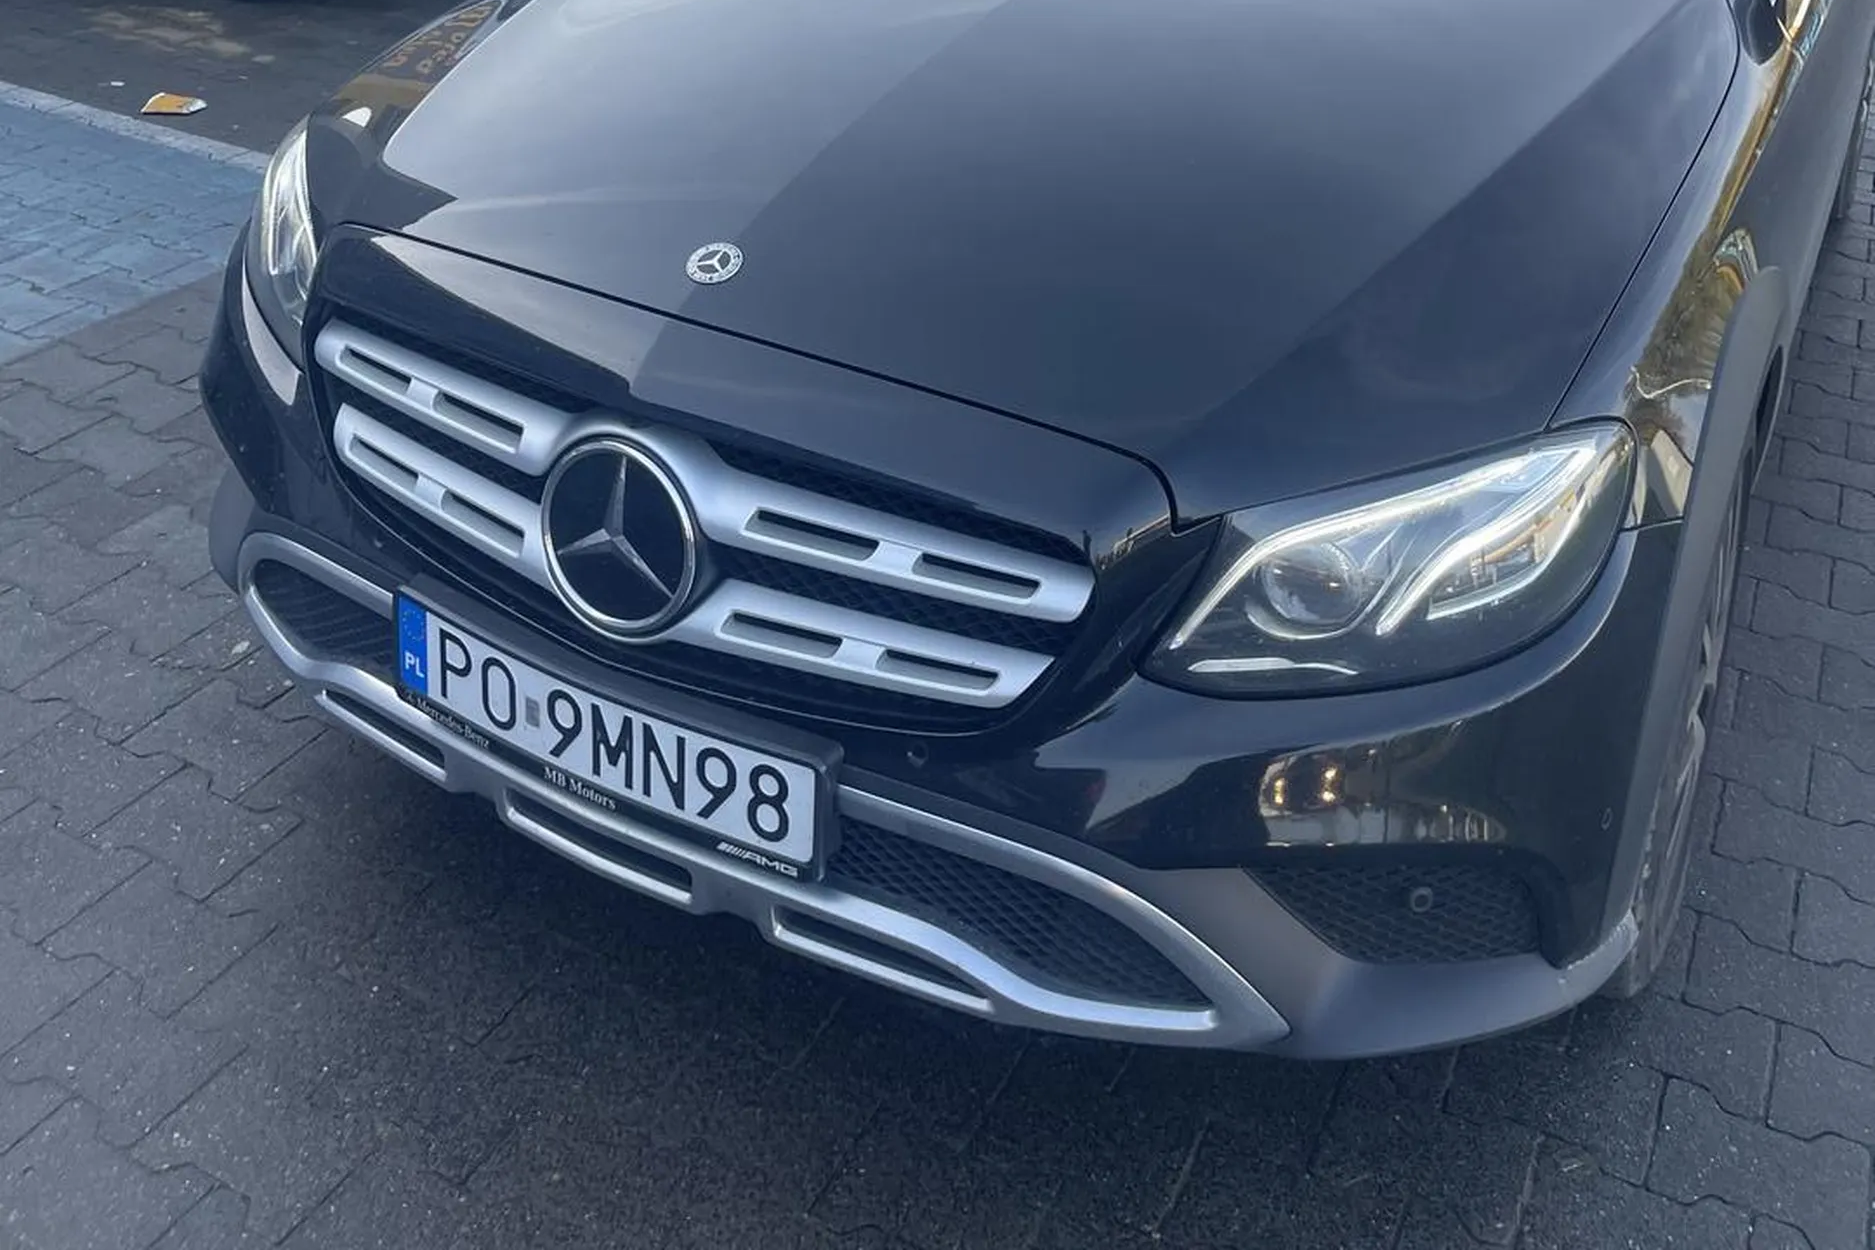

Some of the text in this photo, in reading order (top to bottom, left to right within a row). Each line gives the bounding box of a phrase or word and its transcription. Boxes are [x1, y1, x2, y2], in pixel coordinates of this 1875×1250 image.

[404, 650, 425, 679] PL
[543, 766, 617, 811] MB Motors
[743, 850, 799, 878] AMG
